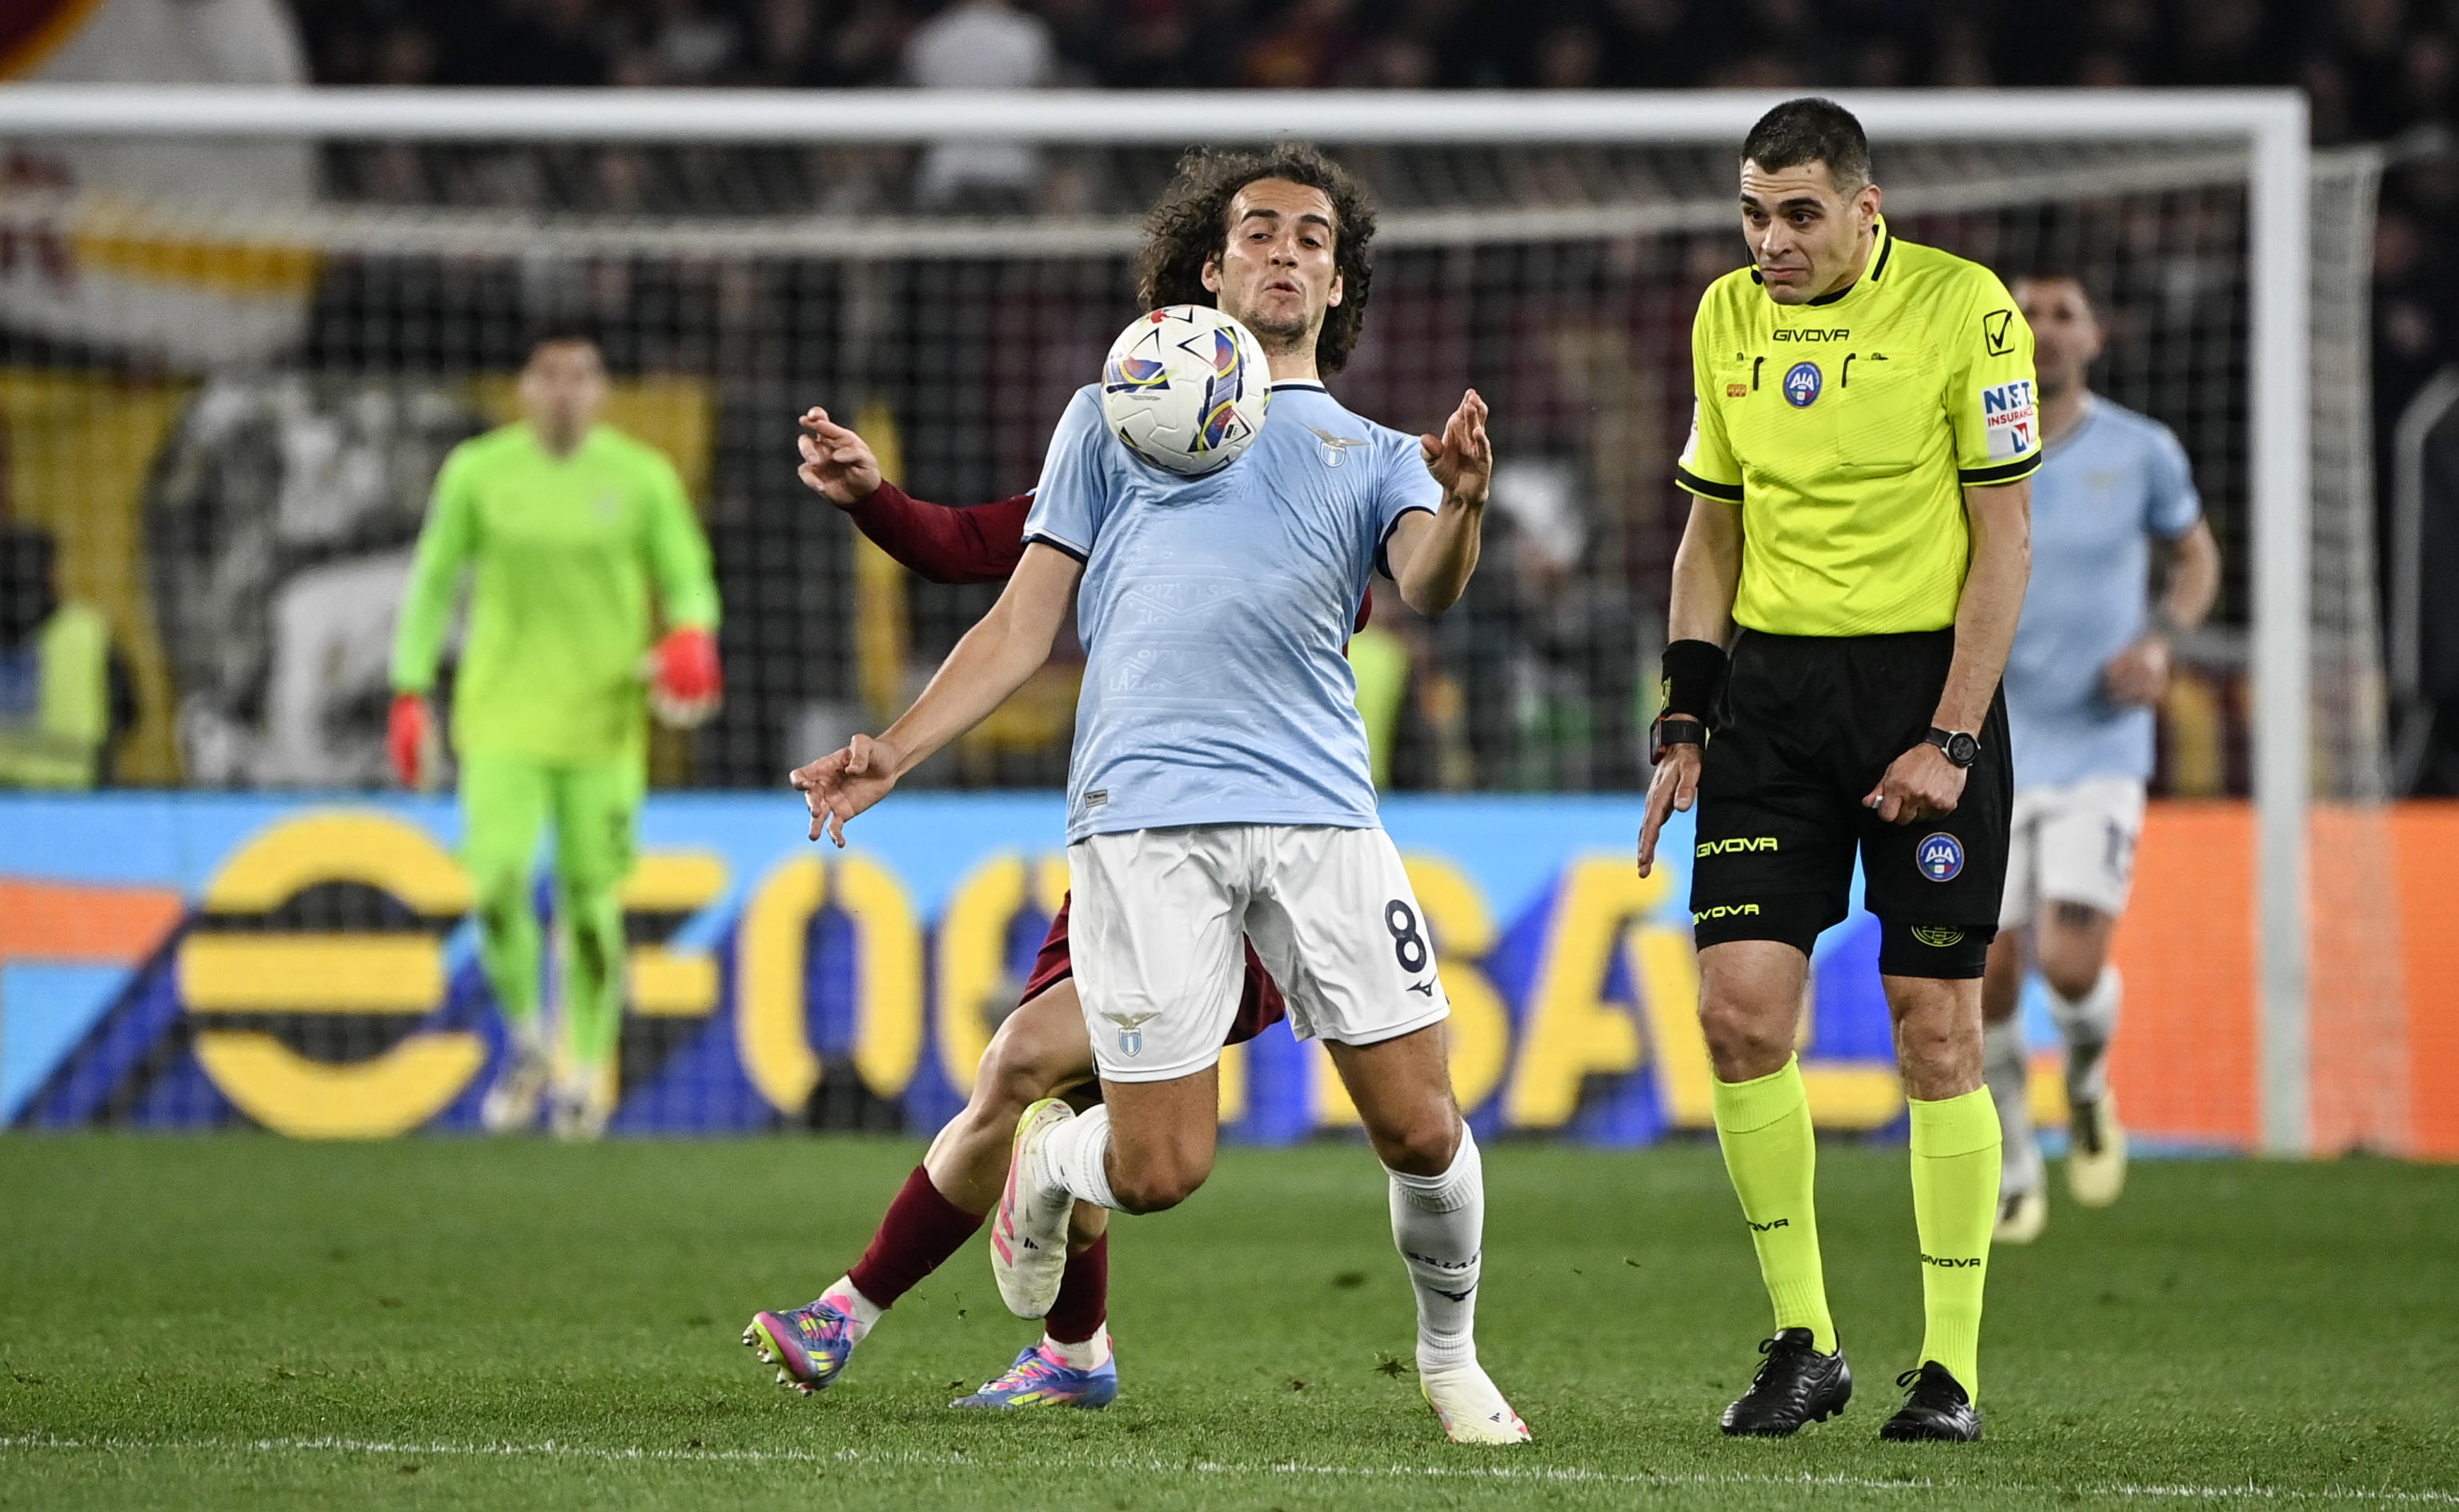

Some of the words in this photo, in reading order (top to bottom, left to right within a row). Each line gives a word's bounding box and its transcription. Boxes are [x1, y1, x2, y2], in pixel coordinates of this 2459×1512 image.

[1772, 329, 1850, 343] GIVOVA
[1984, 381, 2030, 414] NET
[1696, 836, 1779, 858] GIVOVA
[1385, 899, 1427, 974] 8
